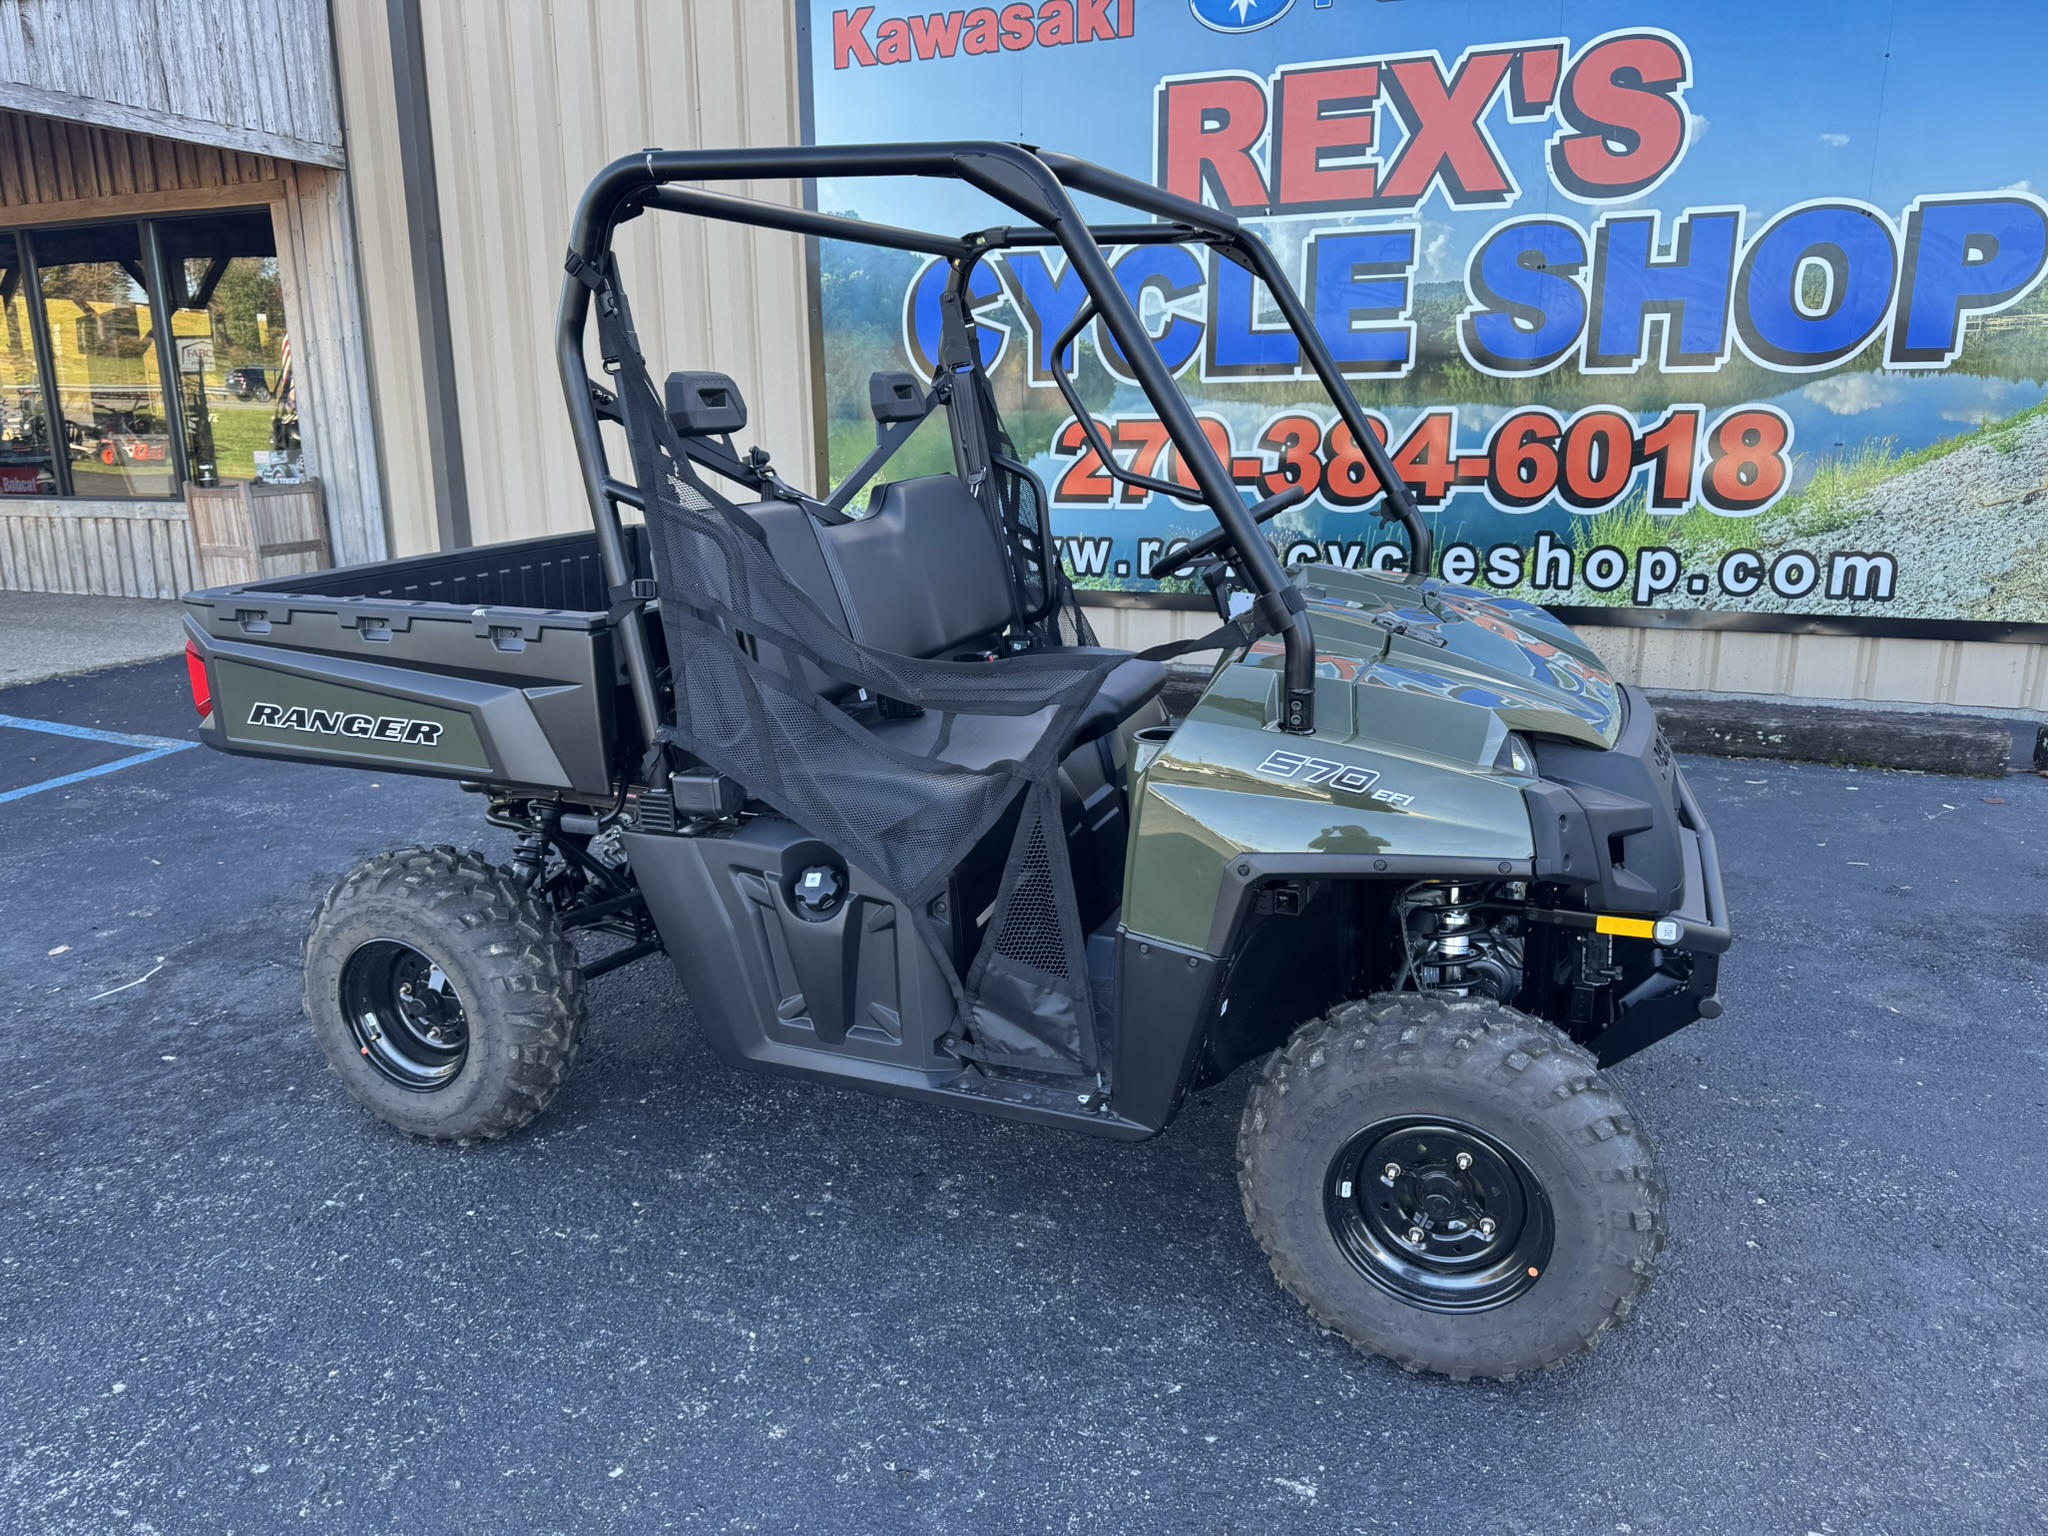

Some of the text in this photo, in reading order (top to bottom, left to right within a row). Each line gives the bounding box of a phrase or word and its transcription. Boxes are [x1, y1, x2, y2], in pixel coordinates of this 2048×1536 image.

[832, 0, 1135, 70] Kawasaki
[1153, 28, 1694, 212] REX'S
[903, 191, 2048, 388] CYCLE SHOP
[2, 477, 37, 493] Bobcat
[1051, 403, 1795, 516] 270-384-6018
[246, 702, 444, 746] RANGER
[1255, 749, 1416, 806] 570 EFI
